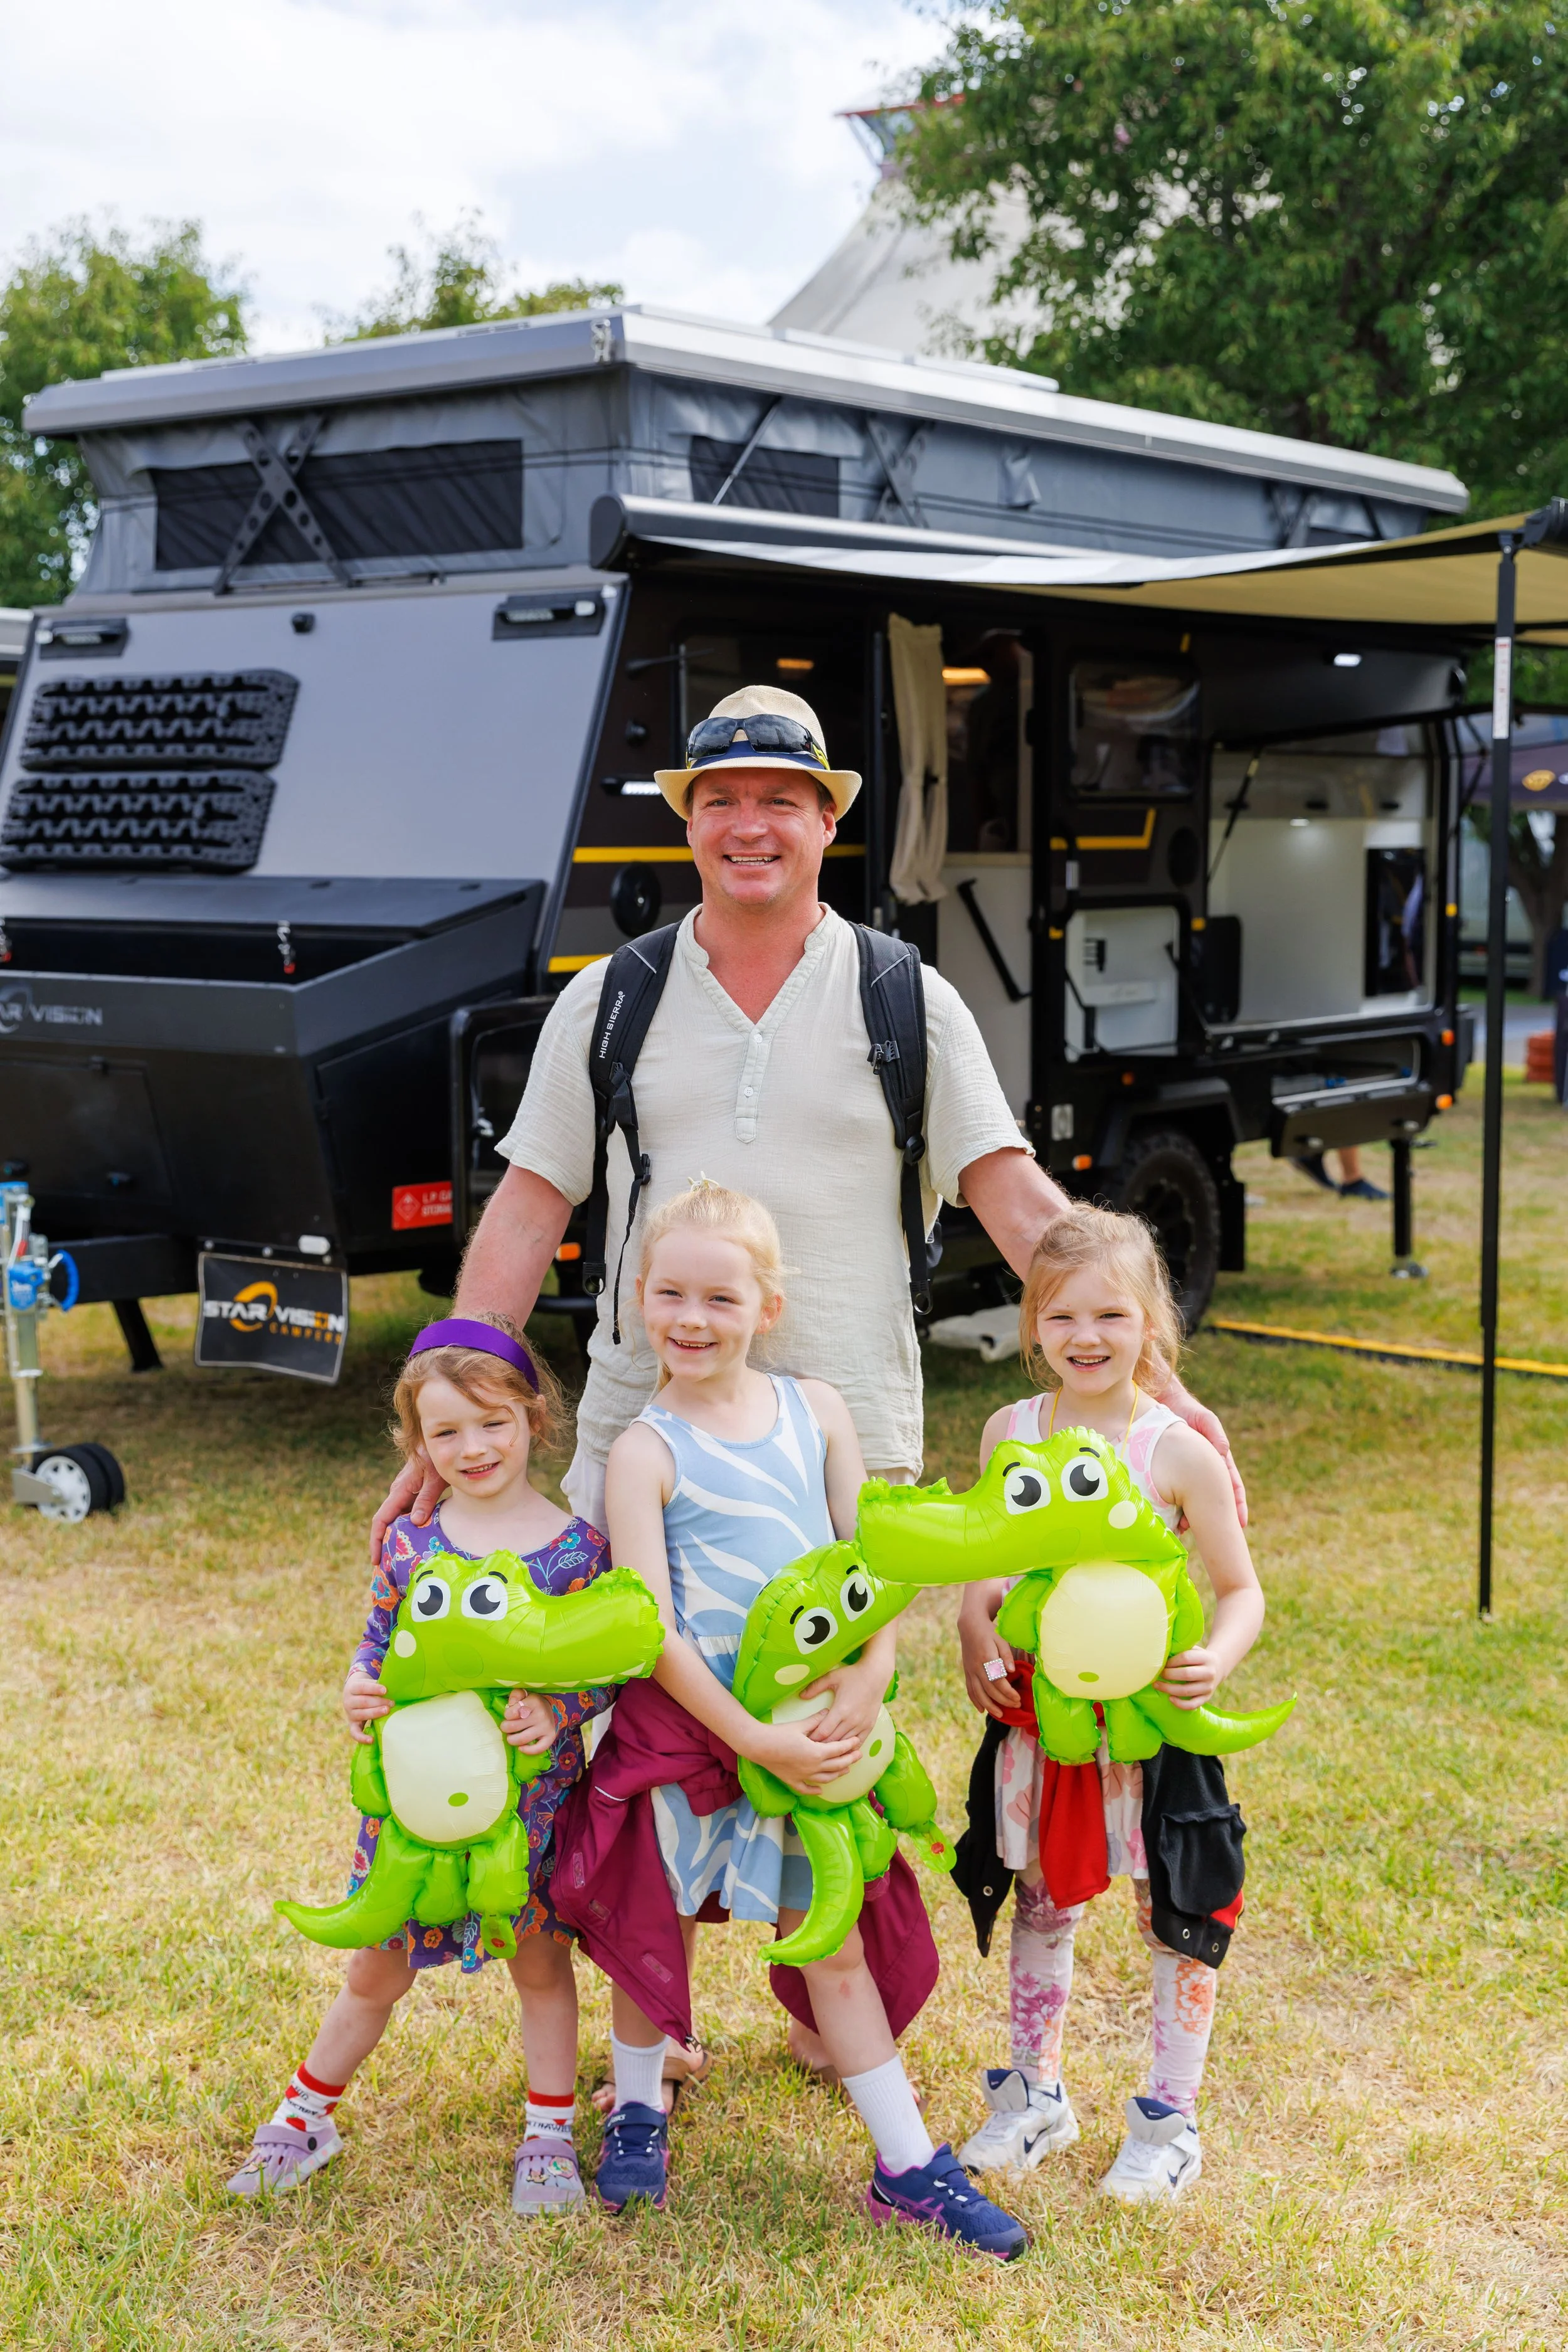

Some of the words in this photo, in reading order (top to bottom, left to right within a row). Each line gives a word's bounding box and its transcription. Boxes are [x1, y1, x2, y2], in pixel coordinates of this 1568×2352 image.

[599, 1032, 611, 1059] HIGH
[203, 1300, 268, 1321] STAR
[273, 1305, 345, 1332] VISION
